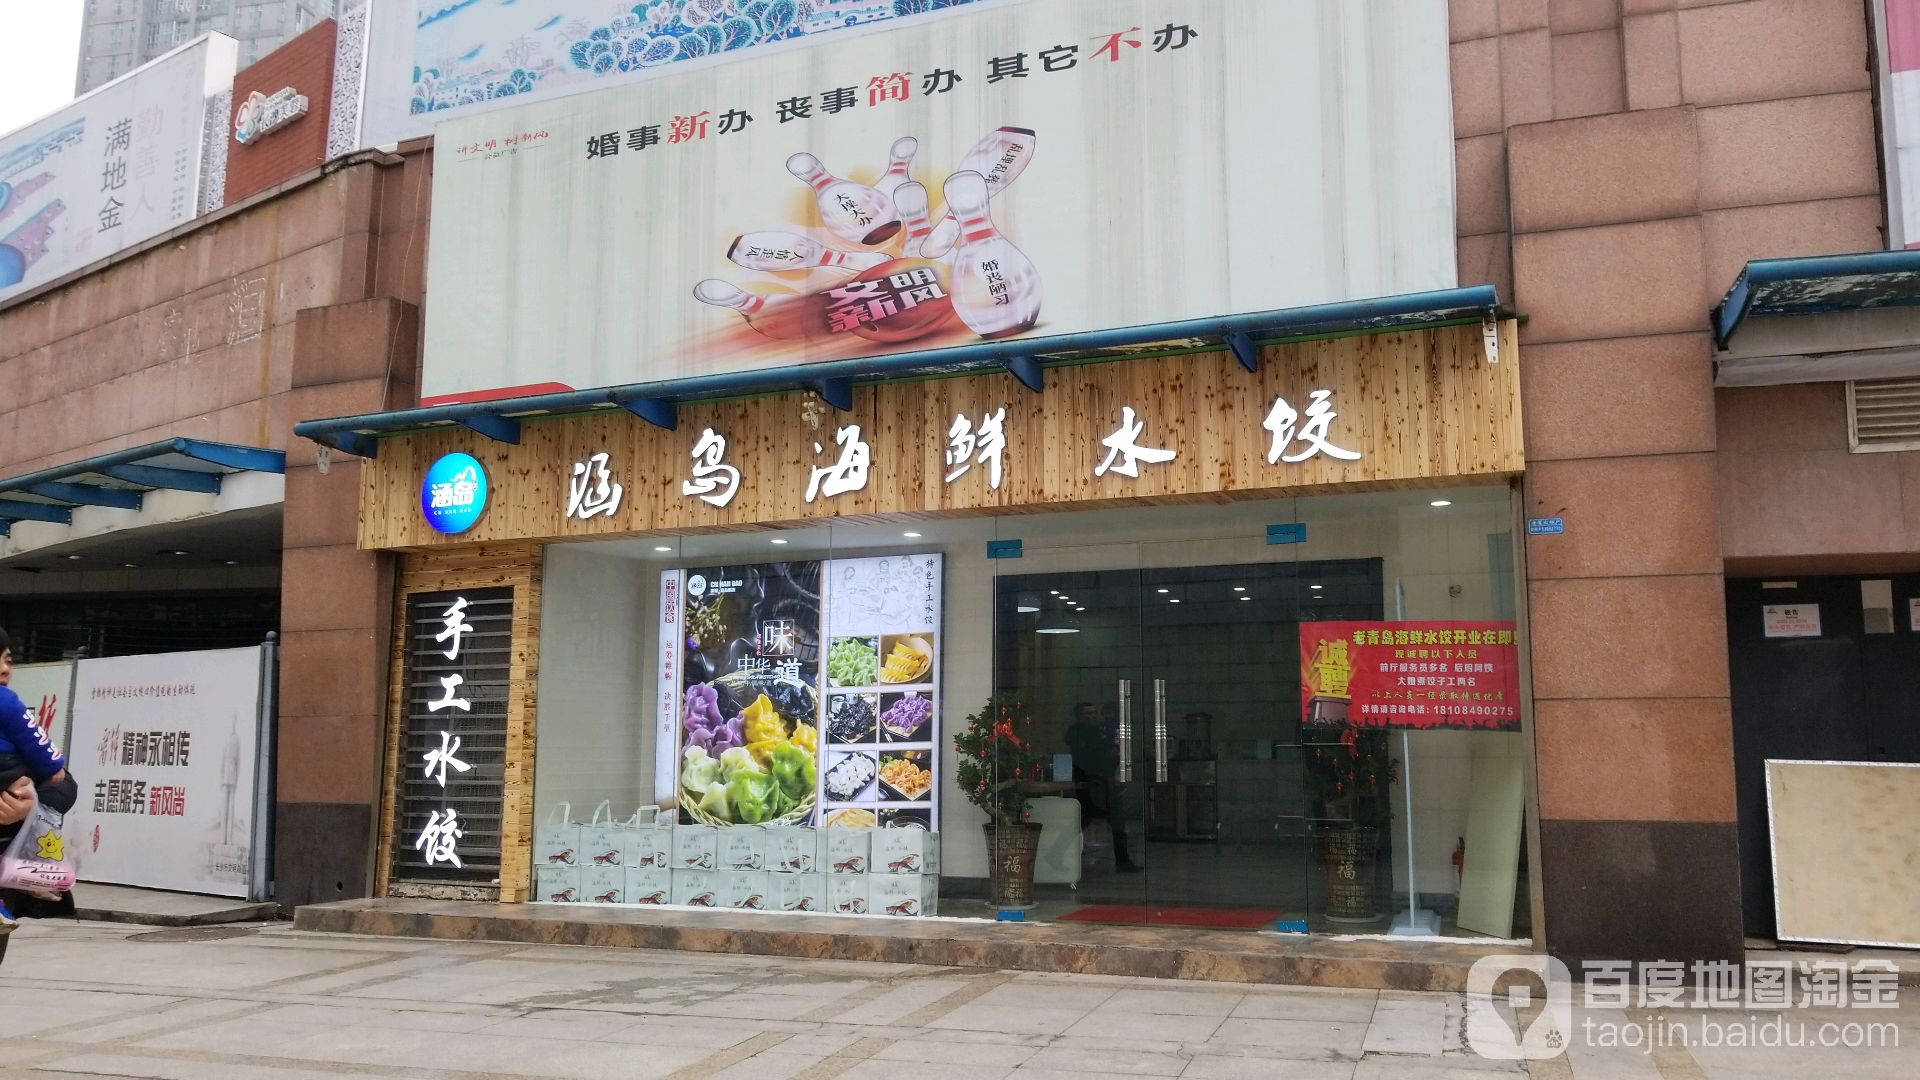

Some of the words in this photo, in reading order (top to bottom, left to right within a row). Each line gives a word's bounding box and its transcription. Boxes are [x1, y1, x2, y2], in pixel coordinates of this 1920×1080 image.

[586, 110, 753, 159] 婚事新办
[775, 71, 962, 124] 丧事简办
[986, 23, 1199, 83] 其它不办
[97, 116, 133, 233] 满地金
[924, 559, 935, 624] 特色手工水饺
[1379, 663, 1448, 673] 前厅服务员多名
[1394, 649, 1478, 659] 现诚聘以下人员
[416, 597, 471, 868] 手工水饺
[149, 785, 186, 817] 新风尚
[1337, 860, 1356, 879] 福
